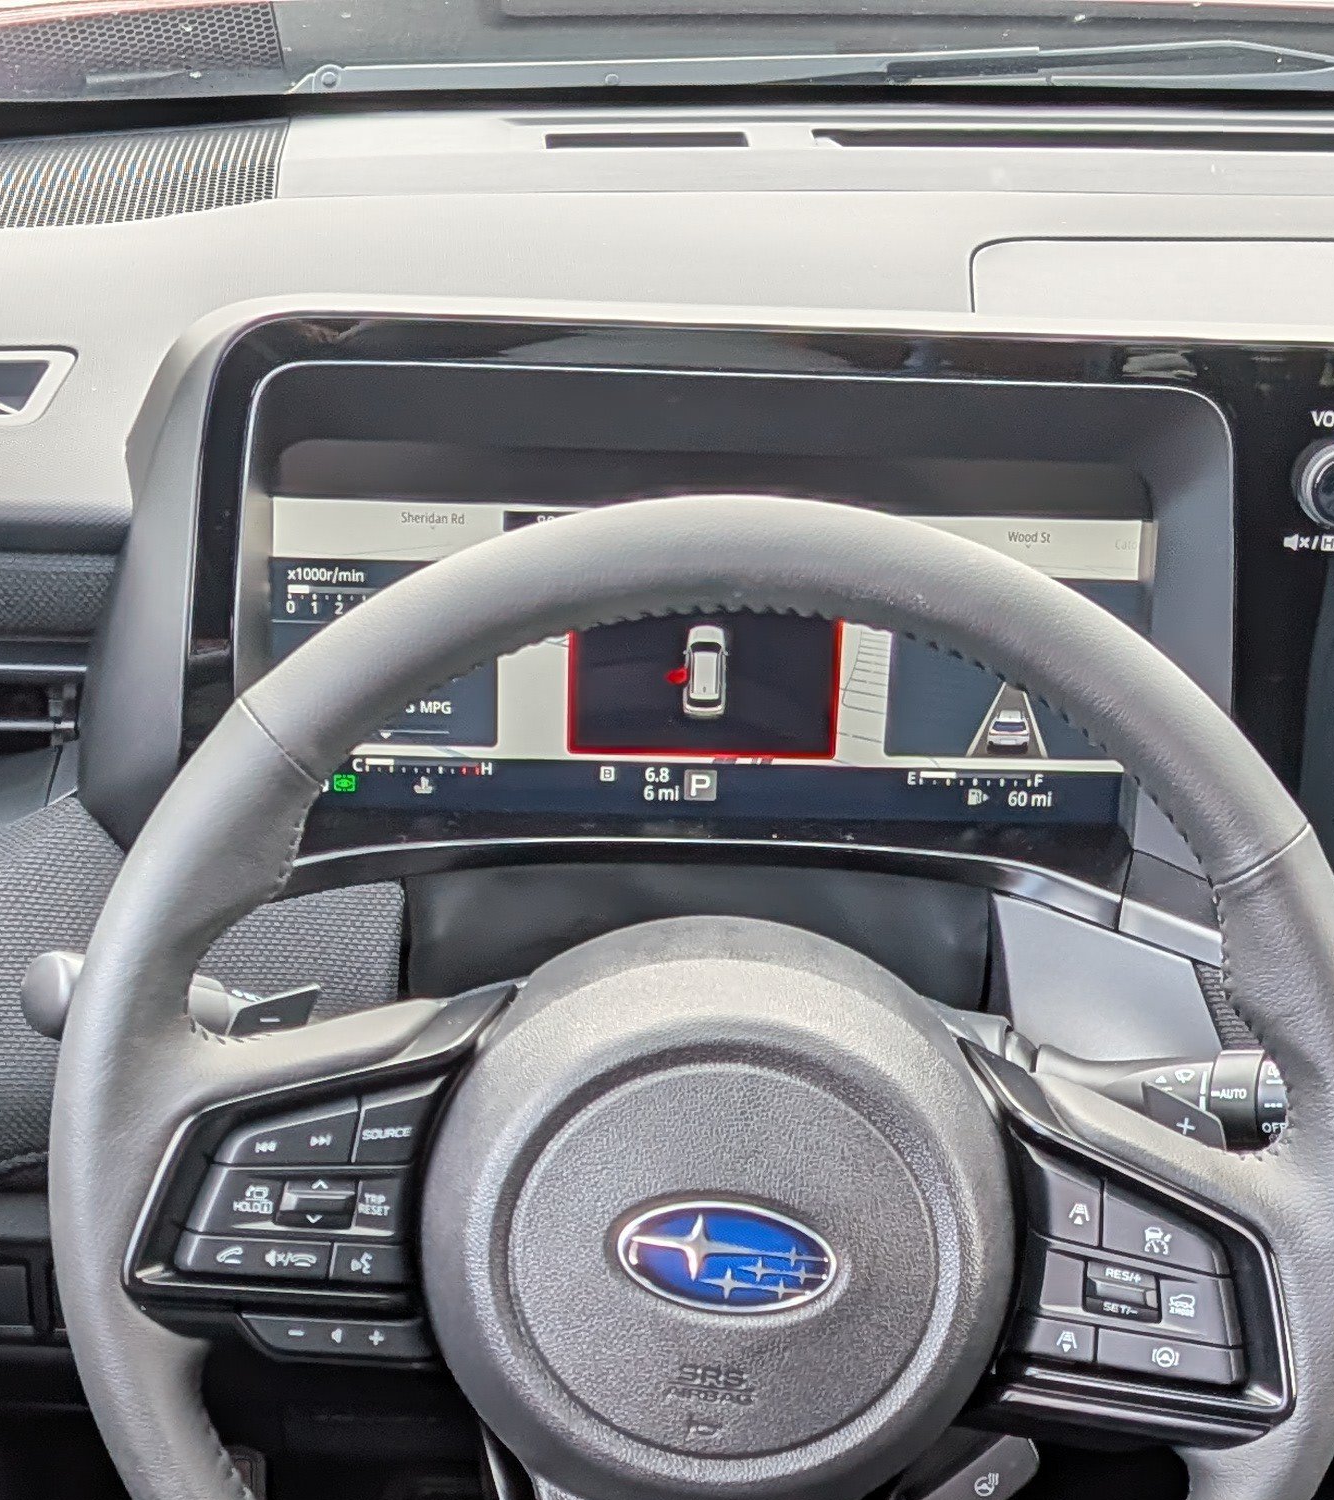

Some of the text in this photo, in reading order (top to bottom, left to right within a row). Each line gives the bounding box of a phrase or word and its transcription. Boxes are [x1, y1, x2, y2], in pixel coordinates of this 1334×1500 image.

[401, 511, 465, 525] Sheridan Rd
[1008, 531, 1051, 544] Wood St
[287, 567, 365, 584] x1000r/min
[286, 600, 344, 615] 0 1 2
[420, 700, 452, 714] MPG
[352, 758, 363, 772] C
[481, 762, 493, 776] H
[644, 767, 670, 783] 6.8
[907, 772, 916, 785] E
[1034, 773, 1044, 788] F
[690, 774, 711, 797] P
[643, 785, 679, 801] 6 mi
[1008, 791, 1053, 807] 60 mi
[1220, 1088, 1247, 1099] AUTO
[362, 1126, 413, 1140] SOURCE
[1262, 1122, 1287, 1133] OFF
